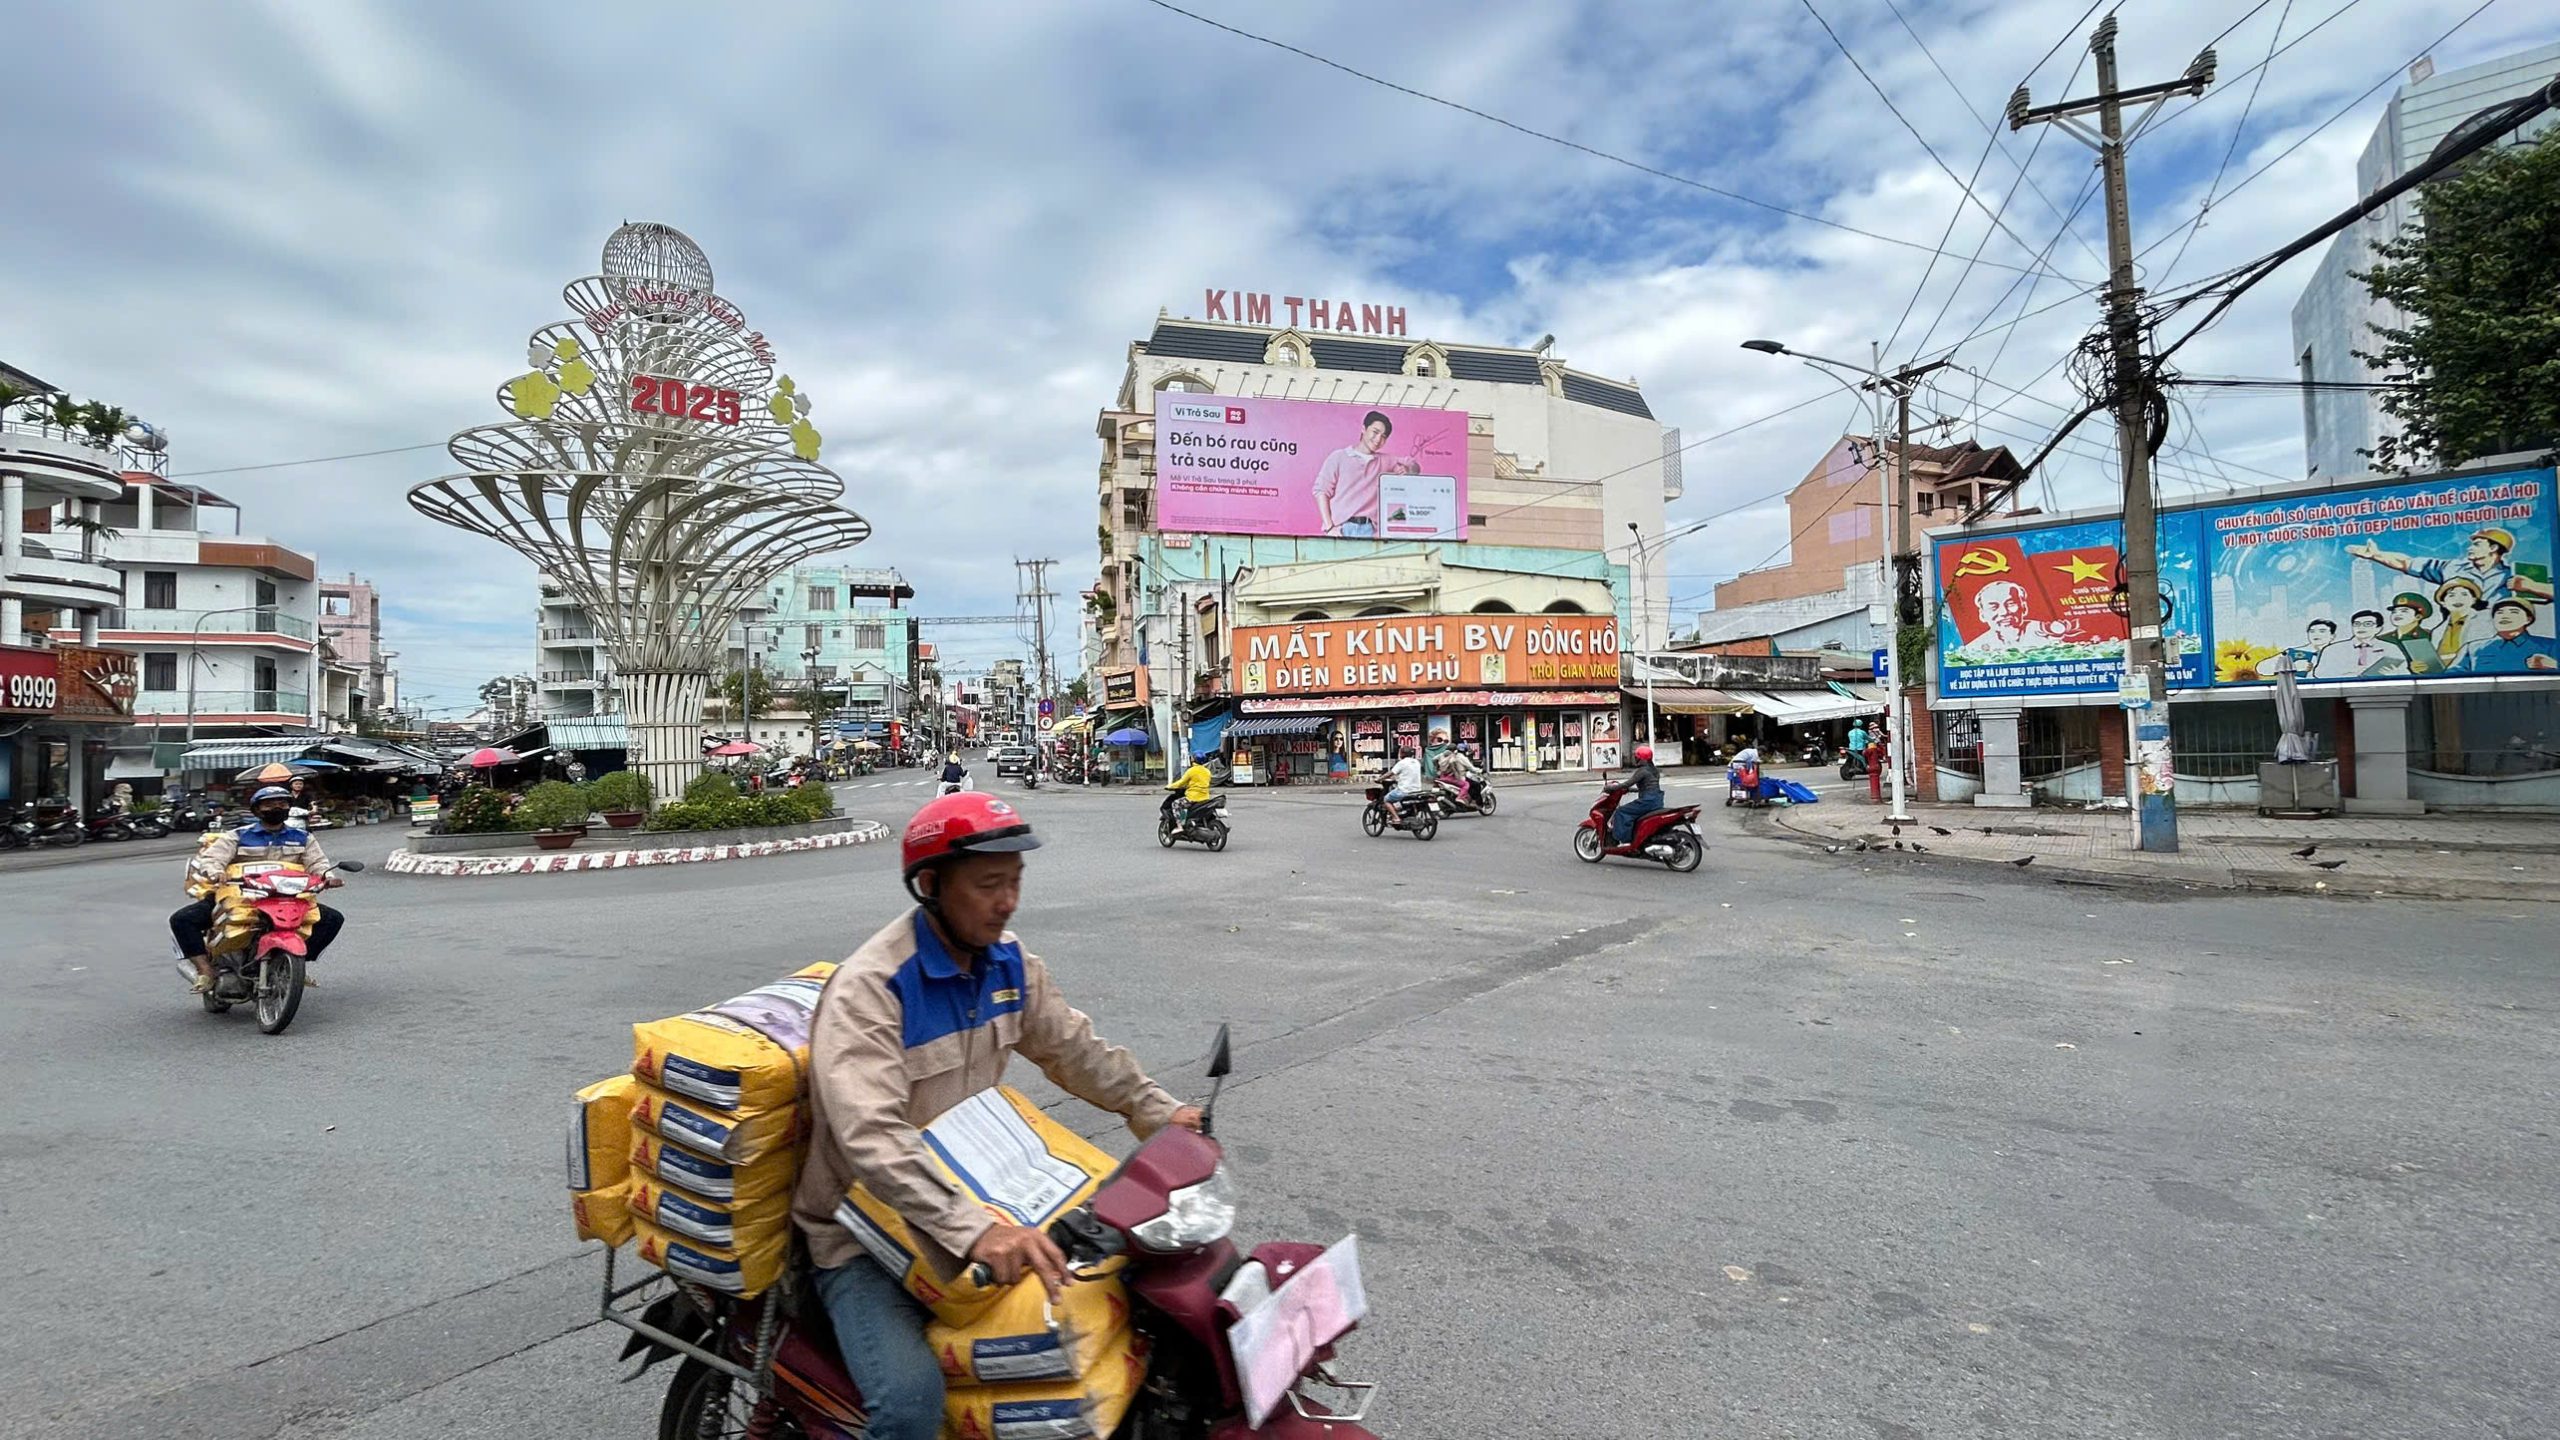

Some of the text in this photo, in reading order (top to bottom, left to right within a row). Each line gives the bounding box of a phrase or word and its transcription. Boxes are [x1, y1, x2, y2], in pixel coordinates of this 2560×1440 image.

[1206, 288, 1406, 336] KIM THANH
[631, 374, 741, 426] 2025
[1175, 408, 1220, 418] Ví Trả Sau
[1170, 432, 1297, 456] Đến bó rau cũng
[1170, 452, 1269, 474] trả sau được
[2216, 481, 2539, 530] CHUYỂN ĐỔI SỐ GIẢI QUYẾT CÁC VẤN ĐỀ CỦA XÃ HỘI
[2224, 503, 2532, 548] VÌ MỘT CUỘC SỐNG TỐT ĐẸP HƠN CHO NGƯỜI DÂN
[2060, 595, 2076, 605] HỒ
[2078, 594, 2098, 603] CHÍ
[1250, 620, 1616, 660] MẮT KÍNH BV ĐỒNG HỒ
[1276, 654, 1460, 691] ĐIỆN BIÊN PHỦ
[1530, 660, 1617, 679] THỜI GIAN VÀNG
[1950, 680, 1958, 690] VỀ
[1989, 679, 1998, 688] VÀ
[2077, 672, 2097, 685] QUYẾT
[1960, 669, 1972, 680] HỌC
[1974, 668, 1985, 678] TẬP
[1986, 668, 1995, 677] VÀ
[2010, 667, 2026, 676] THEO
[2092, 662, 2115, 671] PHONG
[11, 674, 56, 708] 9999
[1496, 715, 1514, 743] 1
